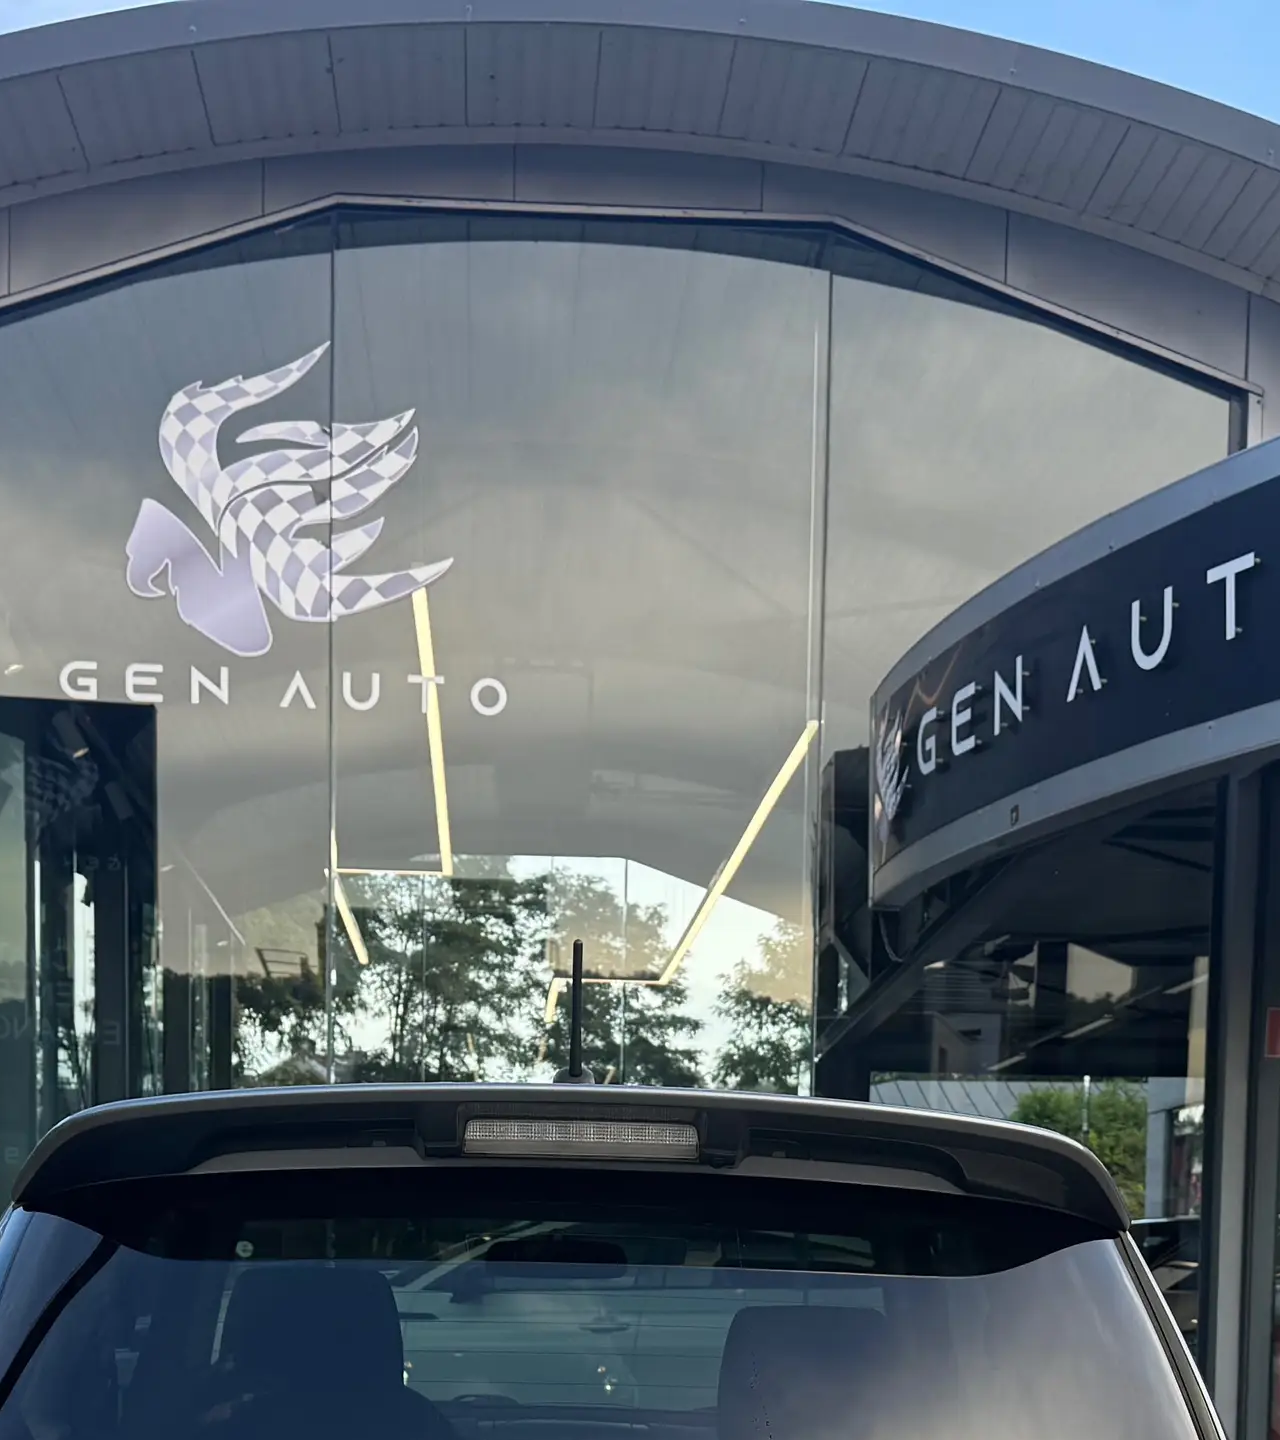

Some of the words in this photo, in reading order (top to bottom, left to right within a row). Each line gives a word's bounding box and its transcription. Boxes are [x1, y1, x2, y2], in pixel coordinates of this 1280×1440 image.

[59, 660, 229, 706] GEN
[279, 670, 508, 717] AUTO
[916, 654, 1024, 776] GEN
